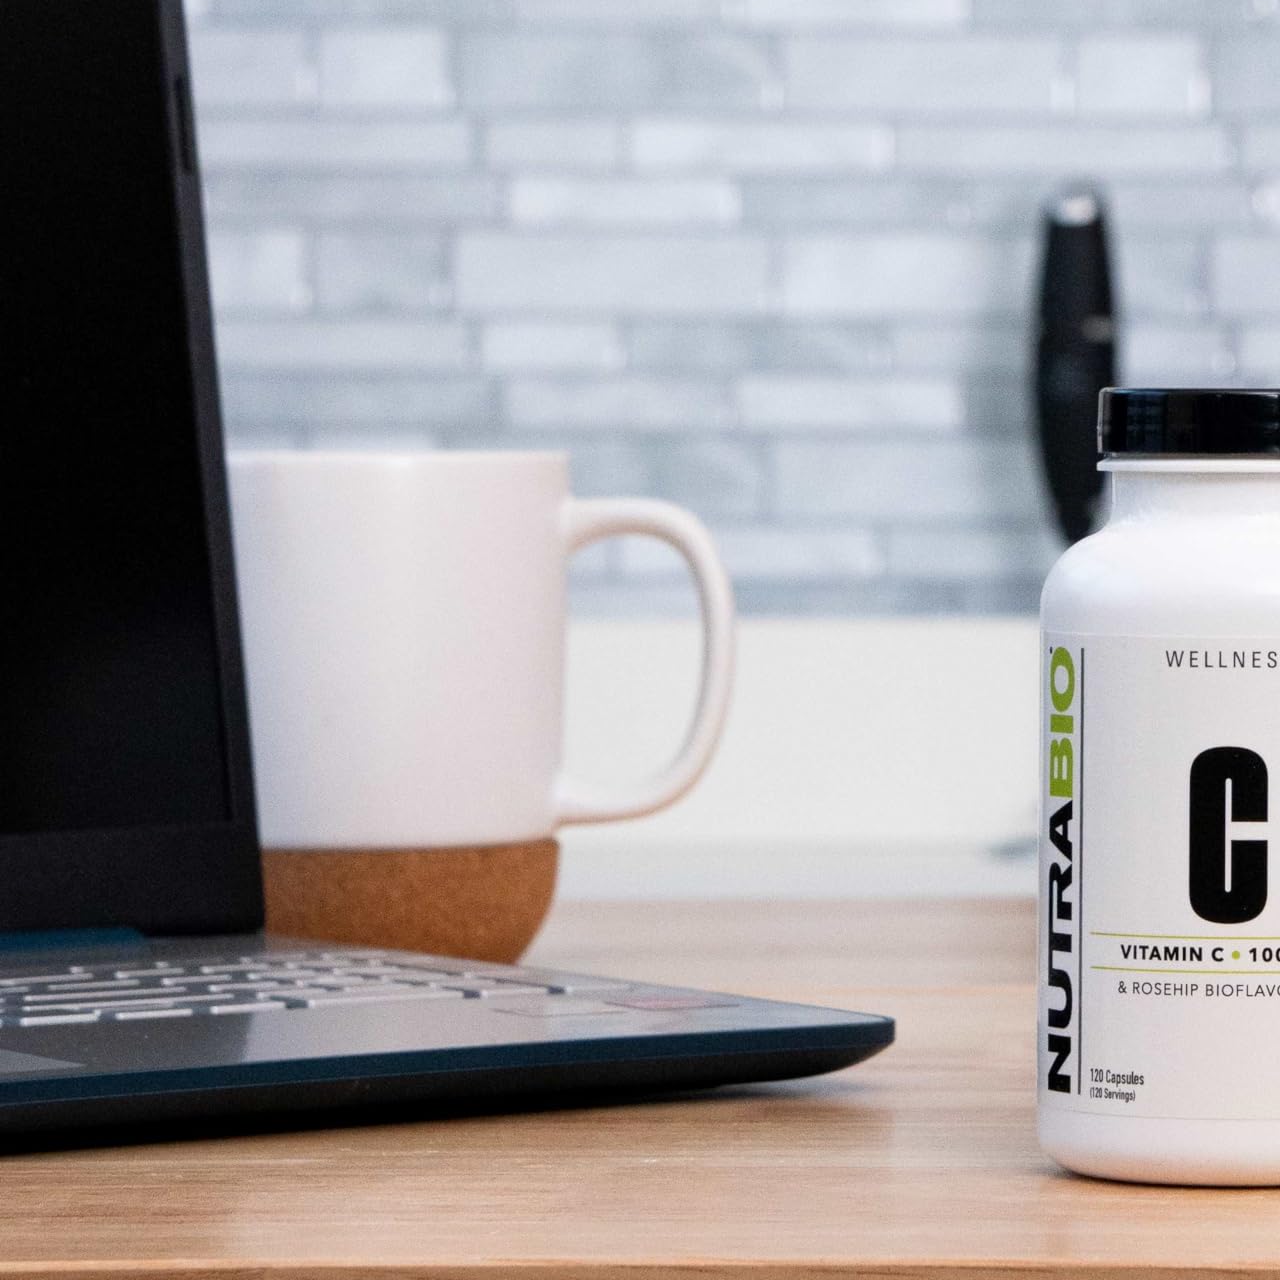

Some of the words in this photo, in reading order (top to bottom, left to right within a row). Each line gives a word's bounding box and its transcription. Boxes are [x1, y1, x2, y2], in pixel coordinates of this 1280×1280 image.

[1189, 746, 1268, 924] C
[1120, 944, 1203, 962] VITAMIN
[1211, 947, 1225, 962] C
[1117, 980, 1127, 994] &
[1132, 981, 1199, 996] ROSEHIP
[1090, 1068, 1104, 1082] 120
[1105, 1069, 1145, 1086] Capsules
[1089, 1086, 1103, 1099] (120
[1104, 1088, 1136, 1103] Servings)
